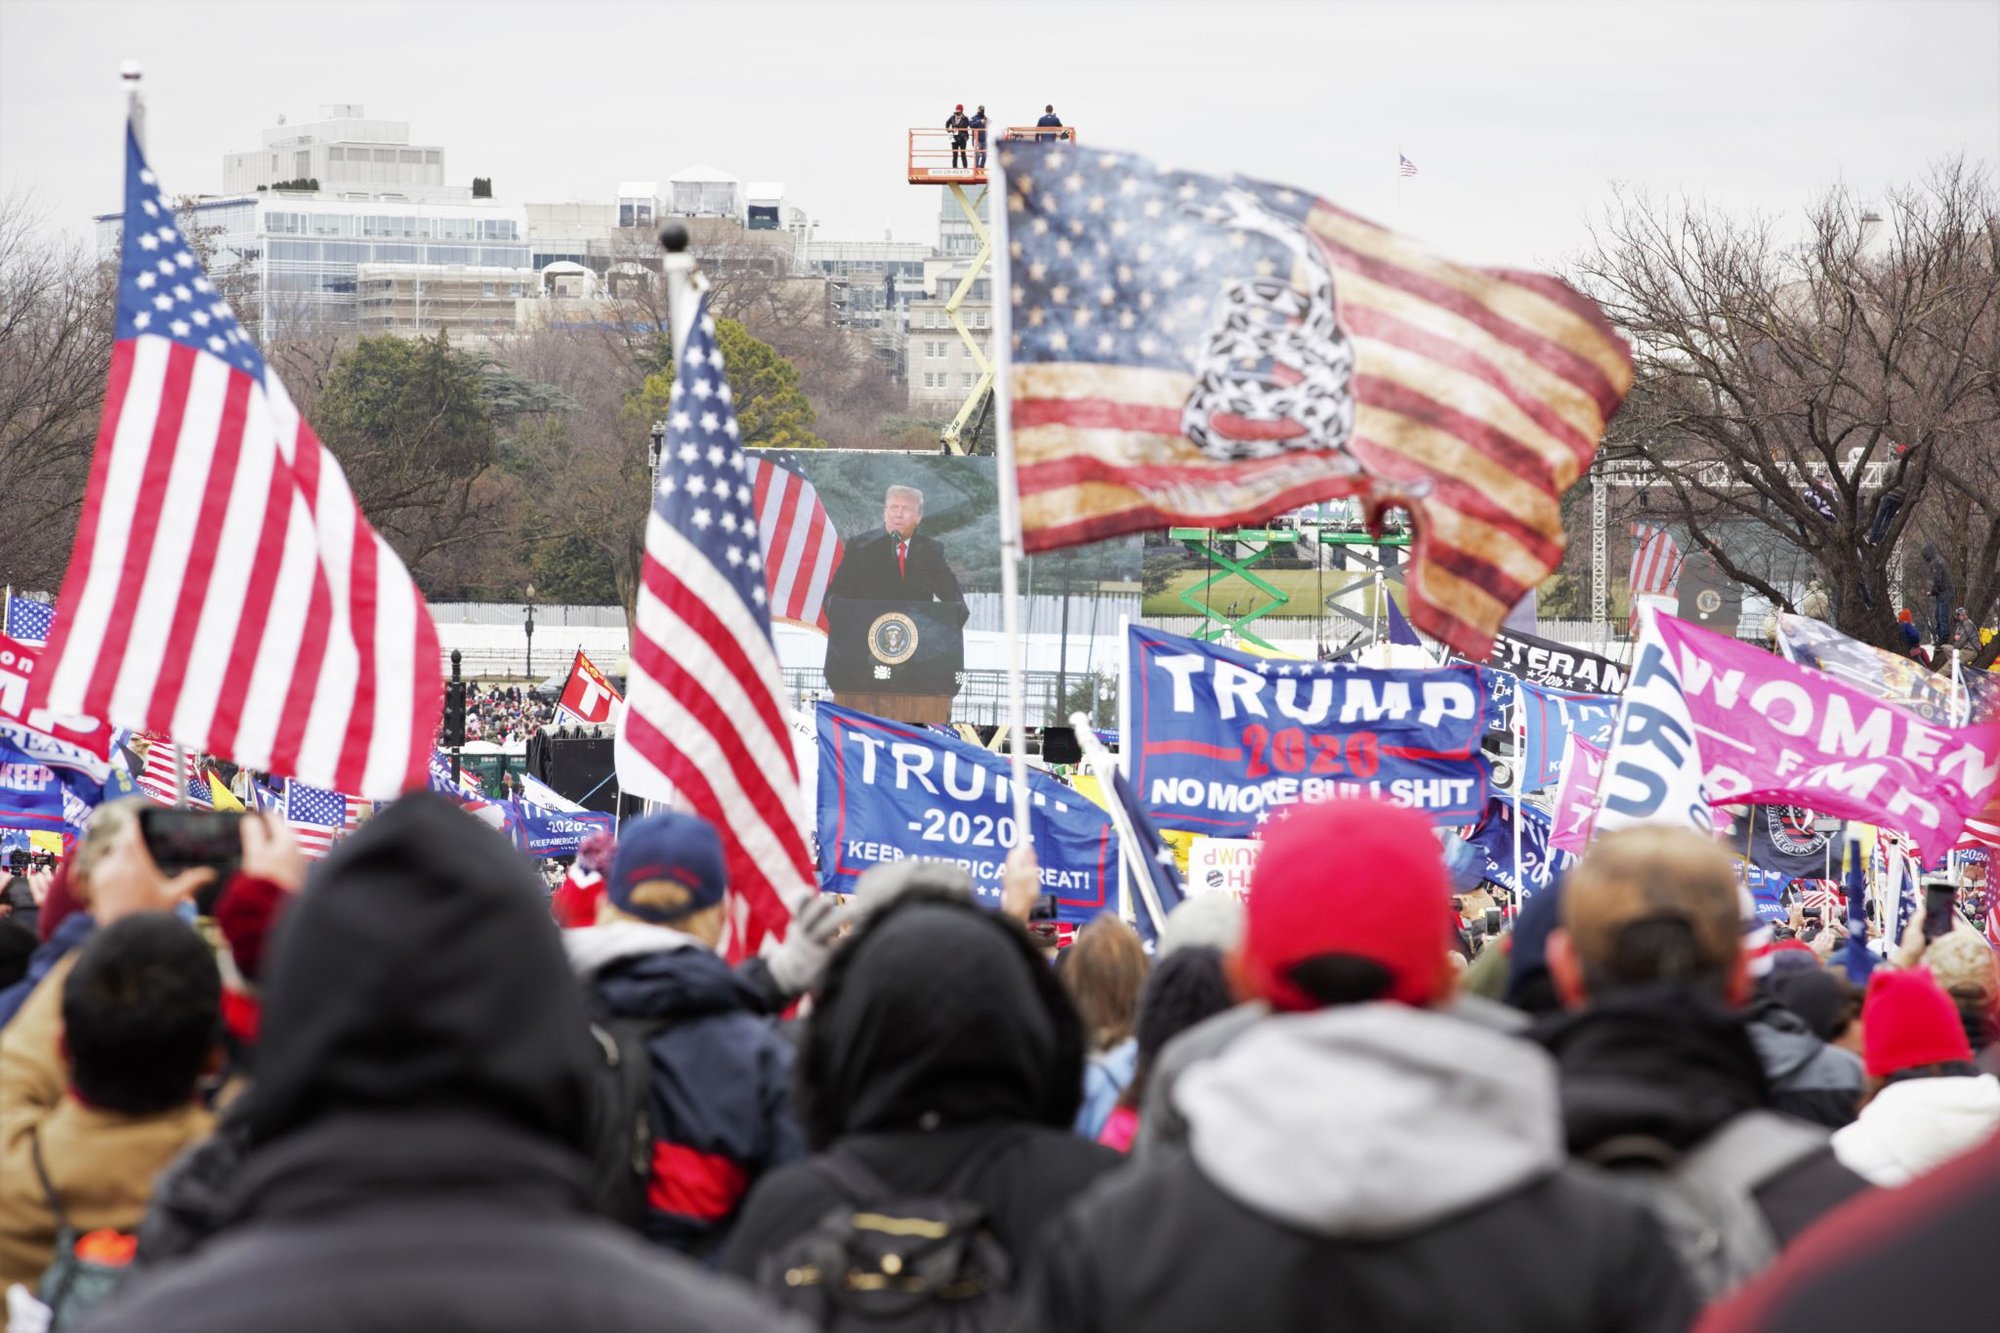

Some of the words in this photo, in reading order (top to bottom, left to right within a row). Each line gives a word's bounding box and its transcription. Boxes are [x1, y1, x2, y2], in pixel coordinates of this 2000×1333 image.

[1155, 653, 1476, 728] TRUMP
[1491, 634, 1627, 694] ETERAN
[1678, 640, 1999, 799] WOMEN
[0, 763, 55, 791] KEEP
[1243, 723, 1380, 778] 2020
[1151, 777, 1205, 807] NO
[1207, 777, 1299, 813] MORE
[1037, 867, 1090, 890] REAT!
